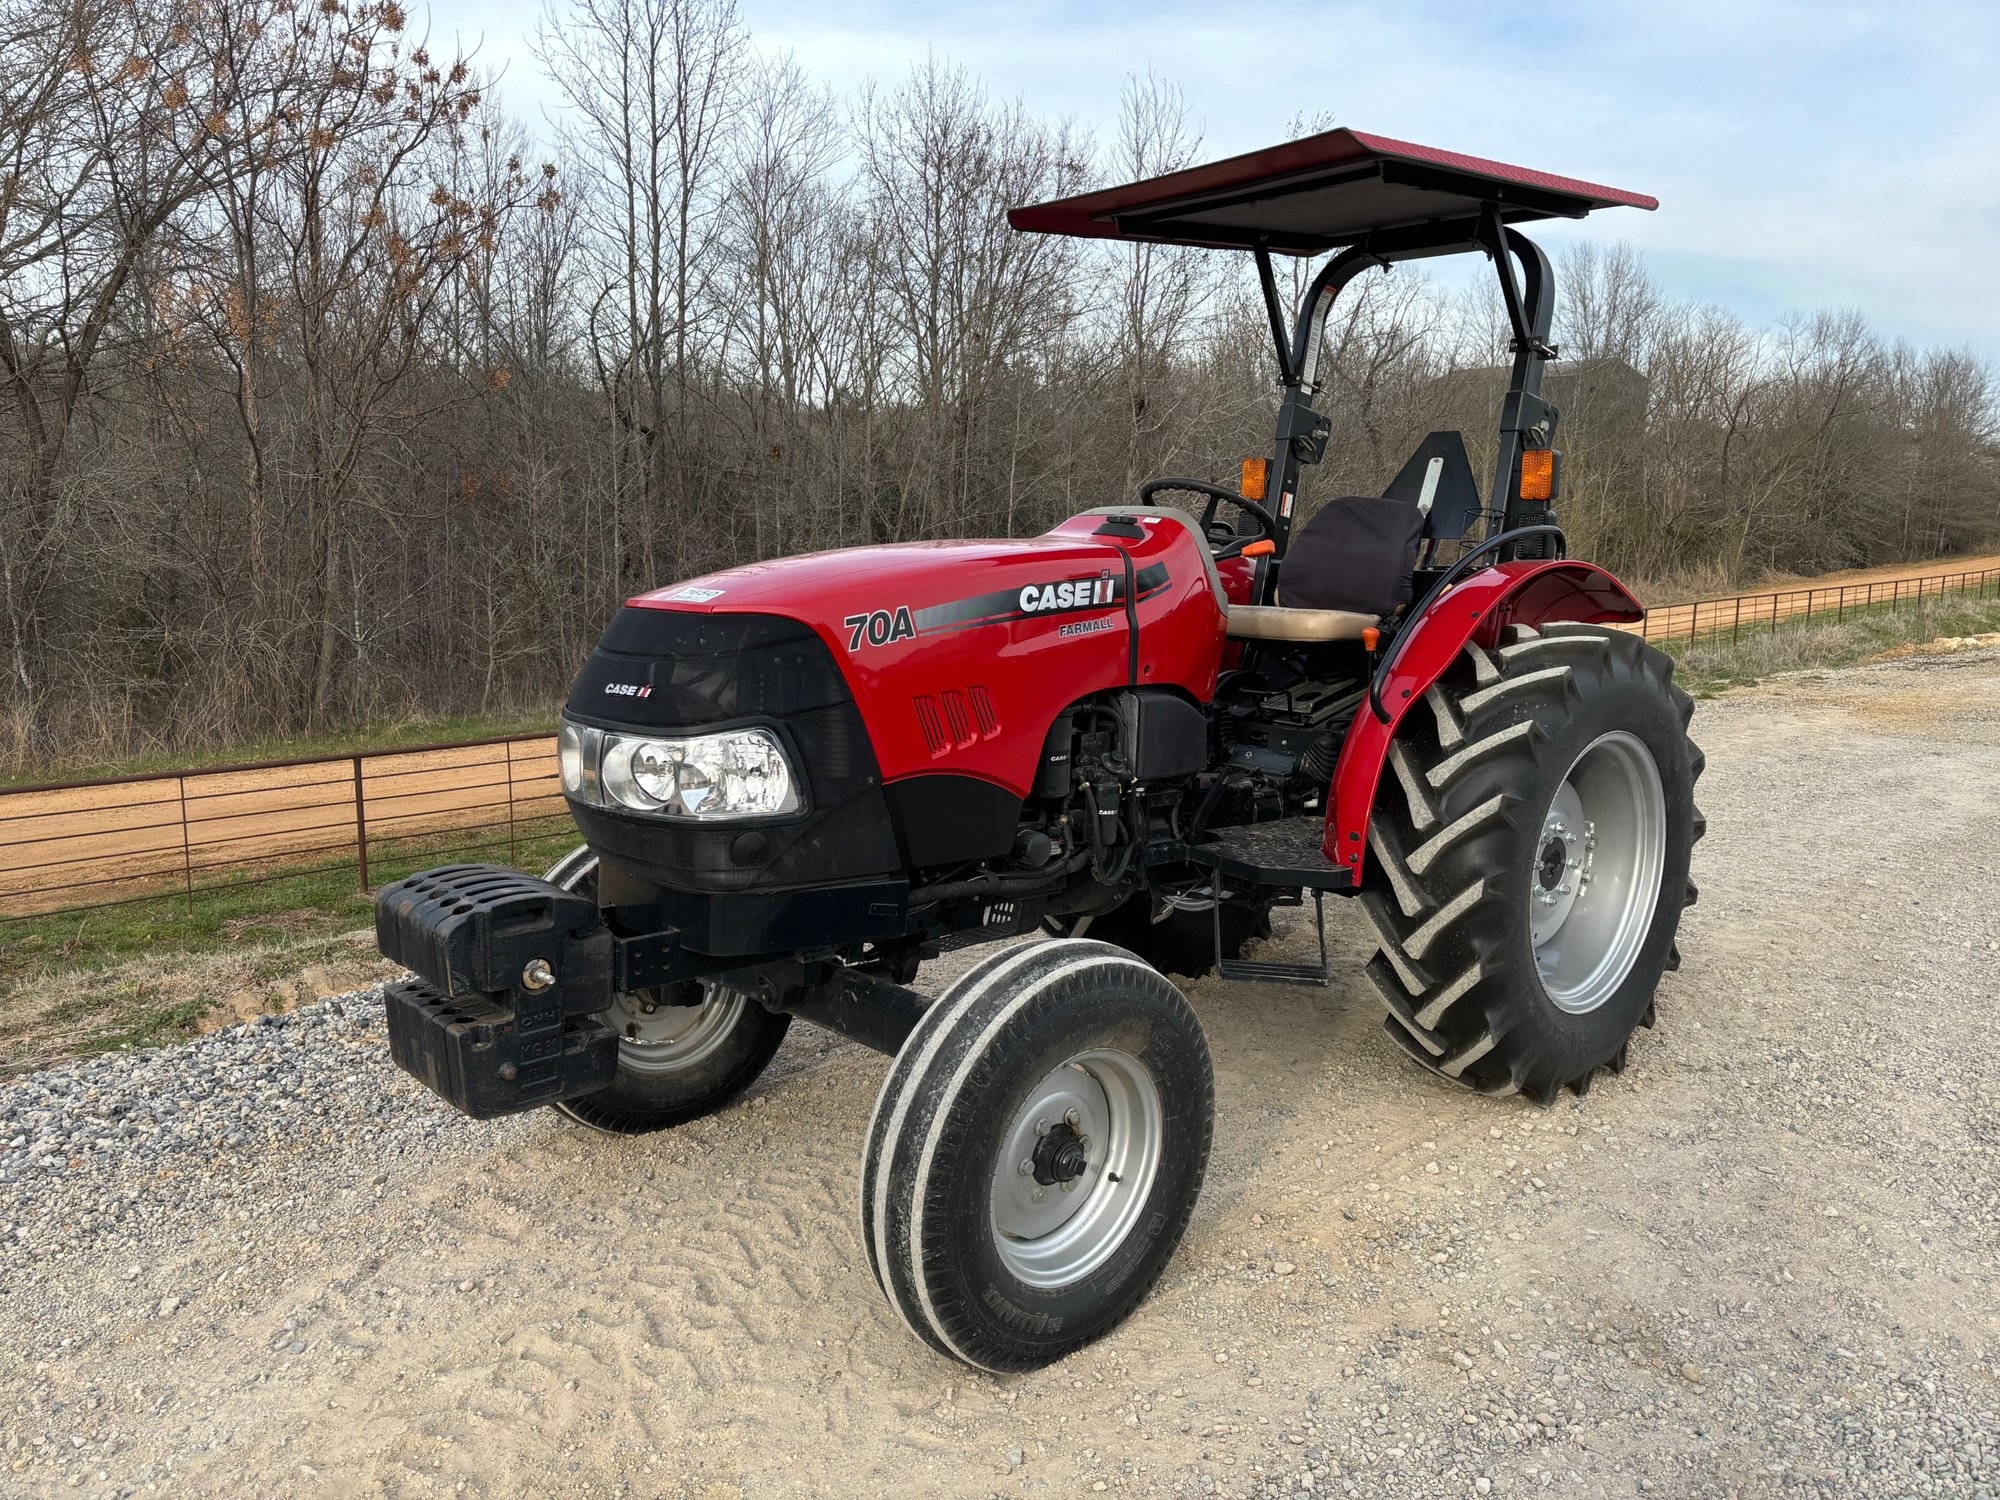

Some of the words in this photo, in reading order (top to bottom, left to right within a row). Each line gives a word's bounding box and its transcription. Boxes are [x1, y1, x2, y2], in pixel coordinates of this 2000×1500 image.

[1019, 582, 1092, 613] CASE
[843, 605, 917, 653] 70A
[1059, 617, 1115, 639] FARMALL
[604, 682, 639, 696] CASE
